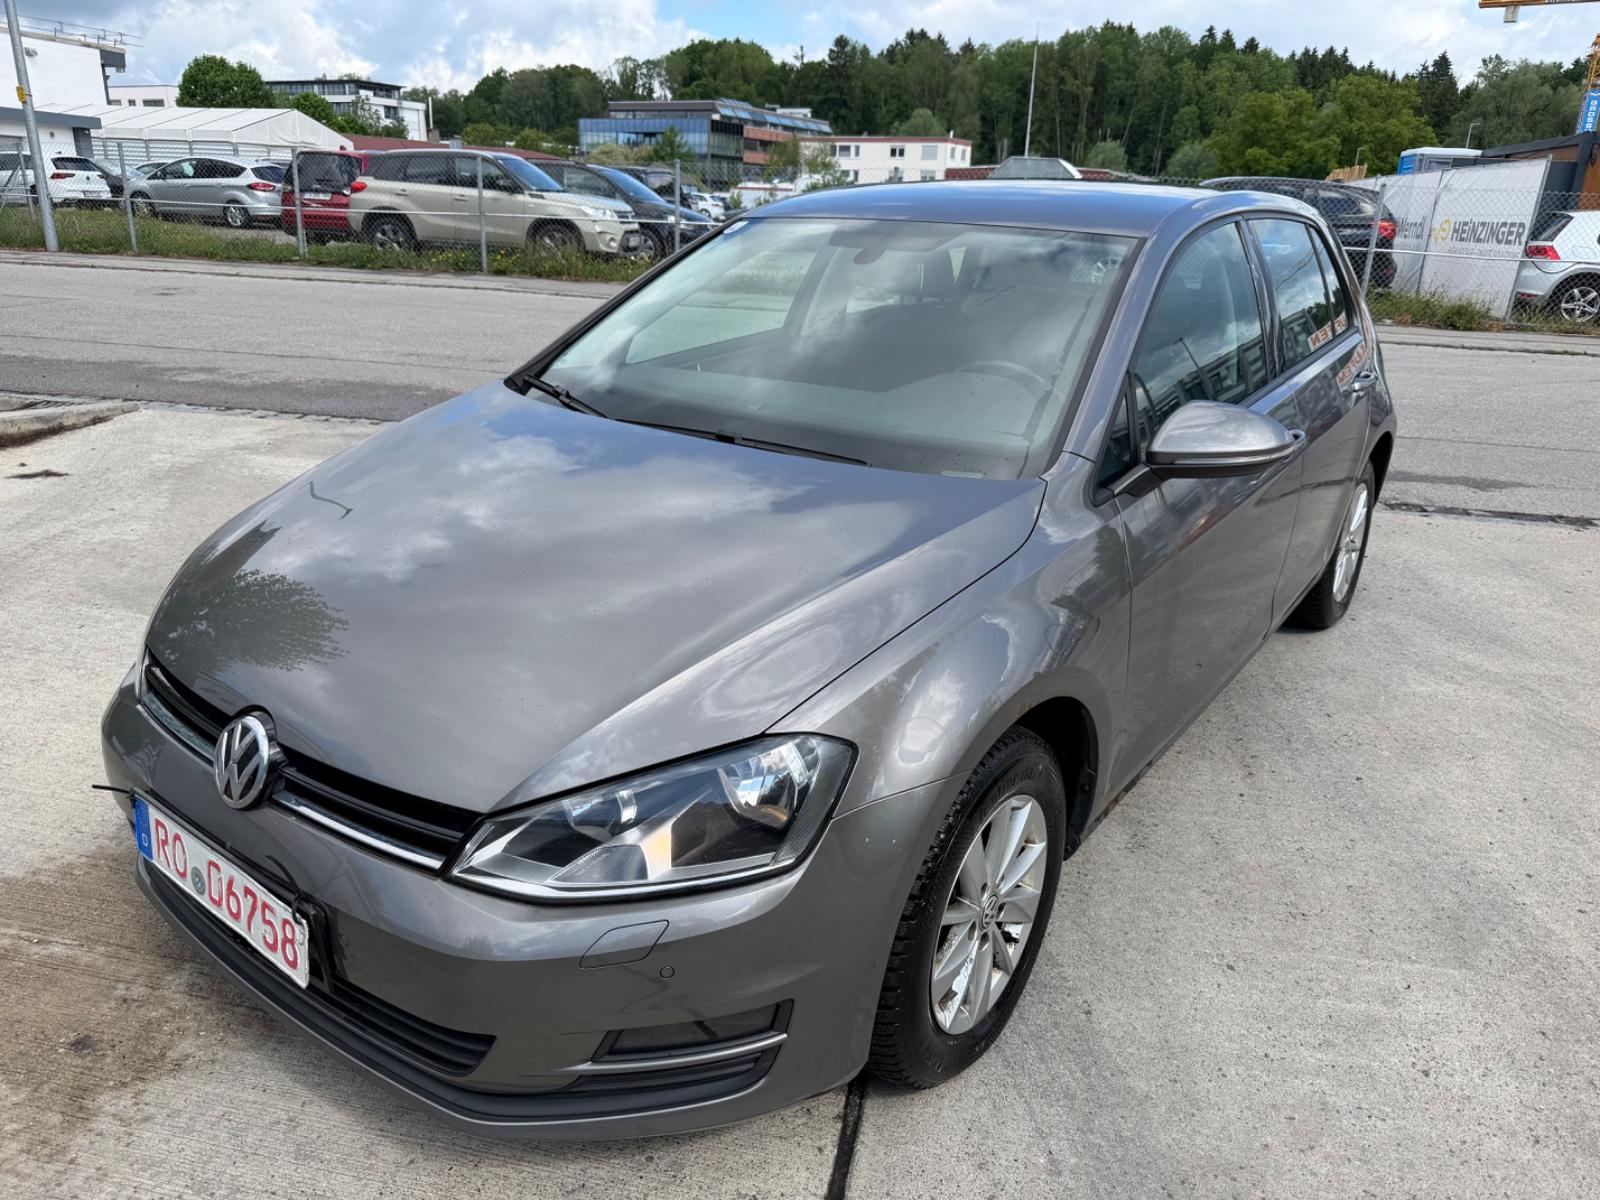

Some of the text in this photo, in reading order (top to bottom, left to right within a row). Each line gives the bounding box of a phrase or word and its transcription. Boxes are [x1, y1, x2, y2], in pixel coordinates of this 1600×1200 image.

[215, 716, 268, 807] VW
[155, 818, 298, 970] RO 06758
